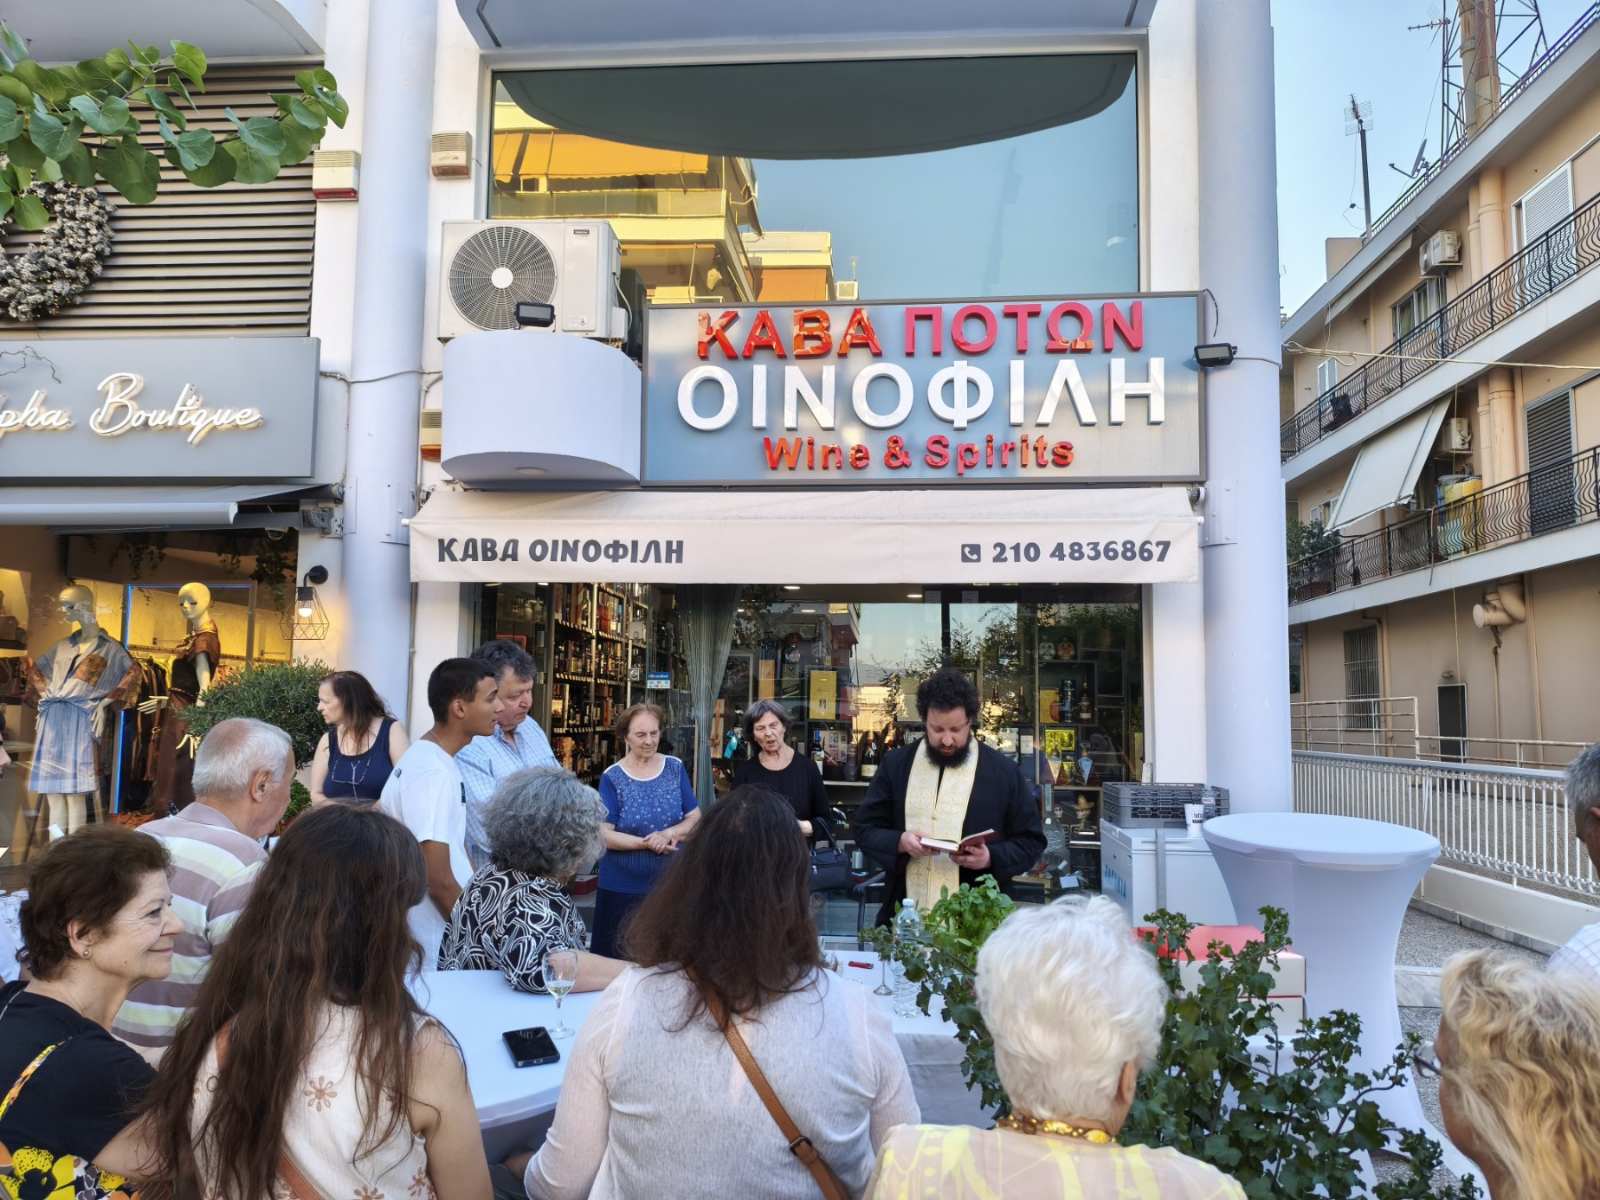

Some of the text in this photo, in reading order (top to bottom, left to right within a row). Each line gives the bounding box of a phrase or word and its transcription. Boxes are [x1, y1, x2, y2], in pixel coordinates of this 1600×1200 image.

[697, 301, 1143, 359] ΚΑΒΑ ΠΟΤΩΝ
[89, 372, 264, 446] Boutique
[677, 357, 1166, 431] ΟΙΝΟΦΙΛΗ
[763, 433, 1074, 476] Wine & Spirits
[437, 537, 684, 563] ΚΑΒΑ ΟΙΝΟΦΙΛΗ
[992, 540, 1171, 563] 210 4836867
